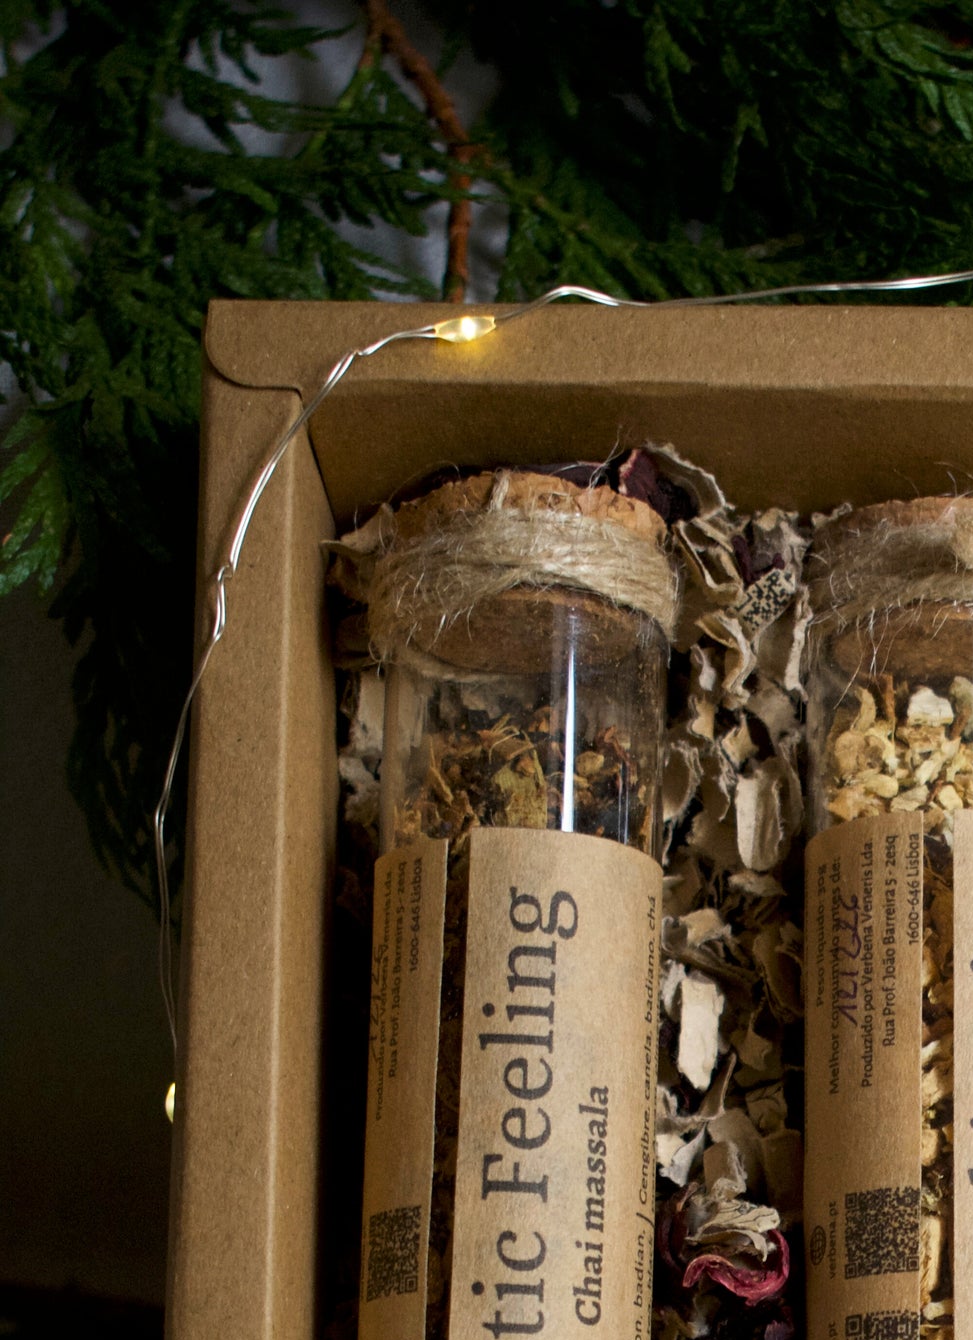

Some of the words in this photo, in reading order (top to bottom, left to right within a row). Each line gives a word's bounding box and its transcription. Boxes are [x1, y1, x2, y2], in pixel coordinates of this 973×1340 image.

[830, 857, 841, 883] de:
[861, 839, 873, 868] Lda.
[885, 835, 899, 867] 2esq
[906, 834, 919, 877] Lisboa
[410, 857, 422, 903] Lisboa
[861, 870, 873, 924] Veneris
[380, 898, 391, 954] Veneris
[647, 895, 656, 931] chá
[831, 886, 841, 932] antes
[883, 888, 897, 944] Barreira
[906, 880, 919, 945] 1600-646
[393, 917, 403, 974] Barreira
[409, 906, 421, 972] 1600-646
[861, 926, 873, 986] Verbena
[882, 948, 896, 979] João
[391, 976, 401, 1009] João
[645, 937, 655, 1024] badiano,
[816, 968, 825, 1007] Peso
[864, 990, 876, 1012] por
[883, 981, 896, 1016] Prof.
[379, 1020, 387, 1044] por
[389, 1011, 399, 1046] Prof.
[479, 885, 580, 1204] Feeling
[861, 1014, 874, 1087] Produzido
[883, 1019, 895, 1046] Rua
[375, 1046, 386, 1120] Produzido
[388, 1050, 398, 1078] Rua
[644, 1030, 653, 1101] canela,
[829, 1033, 840, 1094] Melhor
[577, 1085, 611, 1233] massala
[827, 1200, 839, 1279] verbena.pt
[572, 1241, 606, 1326] Chai
[633, 1230, 646, 1308] badian,
